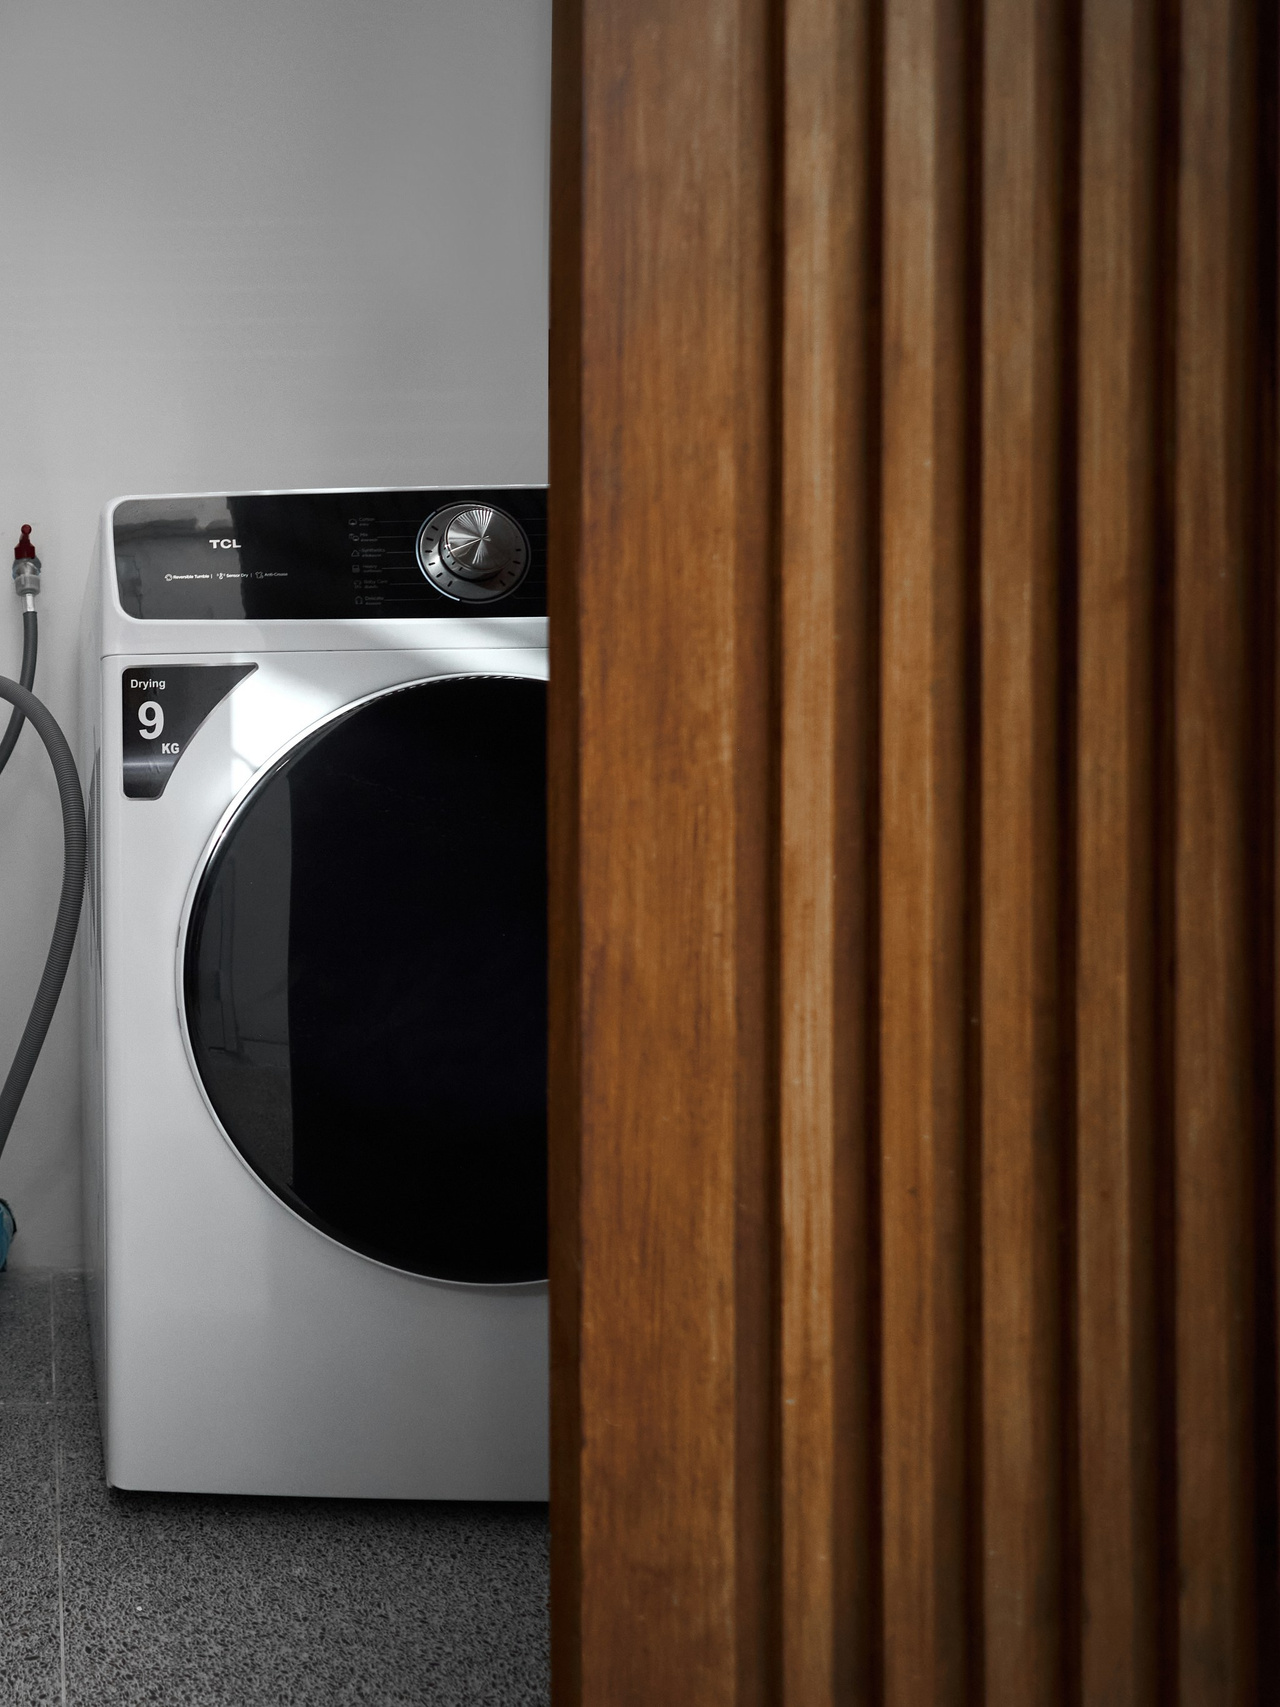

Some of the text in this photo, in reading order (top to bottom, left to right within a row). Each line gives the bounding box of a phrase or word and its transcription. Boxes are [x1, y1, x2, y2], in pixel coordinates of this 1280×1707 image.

[209, 539, 241, 549] TCL
[130, 679, 166, 690] Drying
[138, 701, 164, 740] 9
[162, 743, 180, 754] KG
